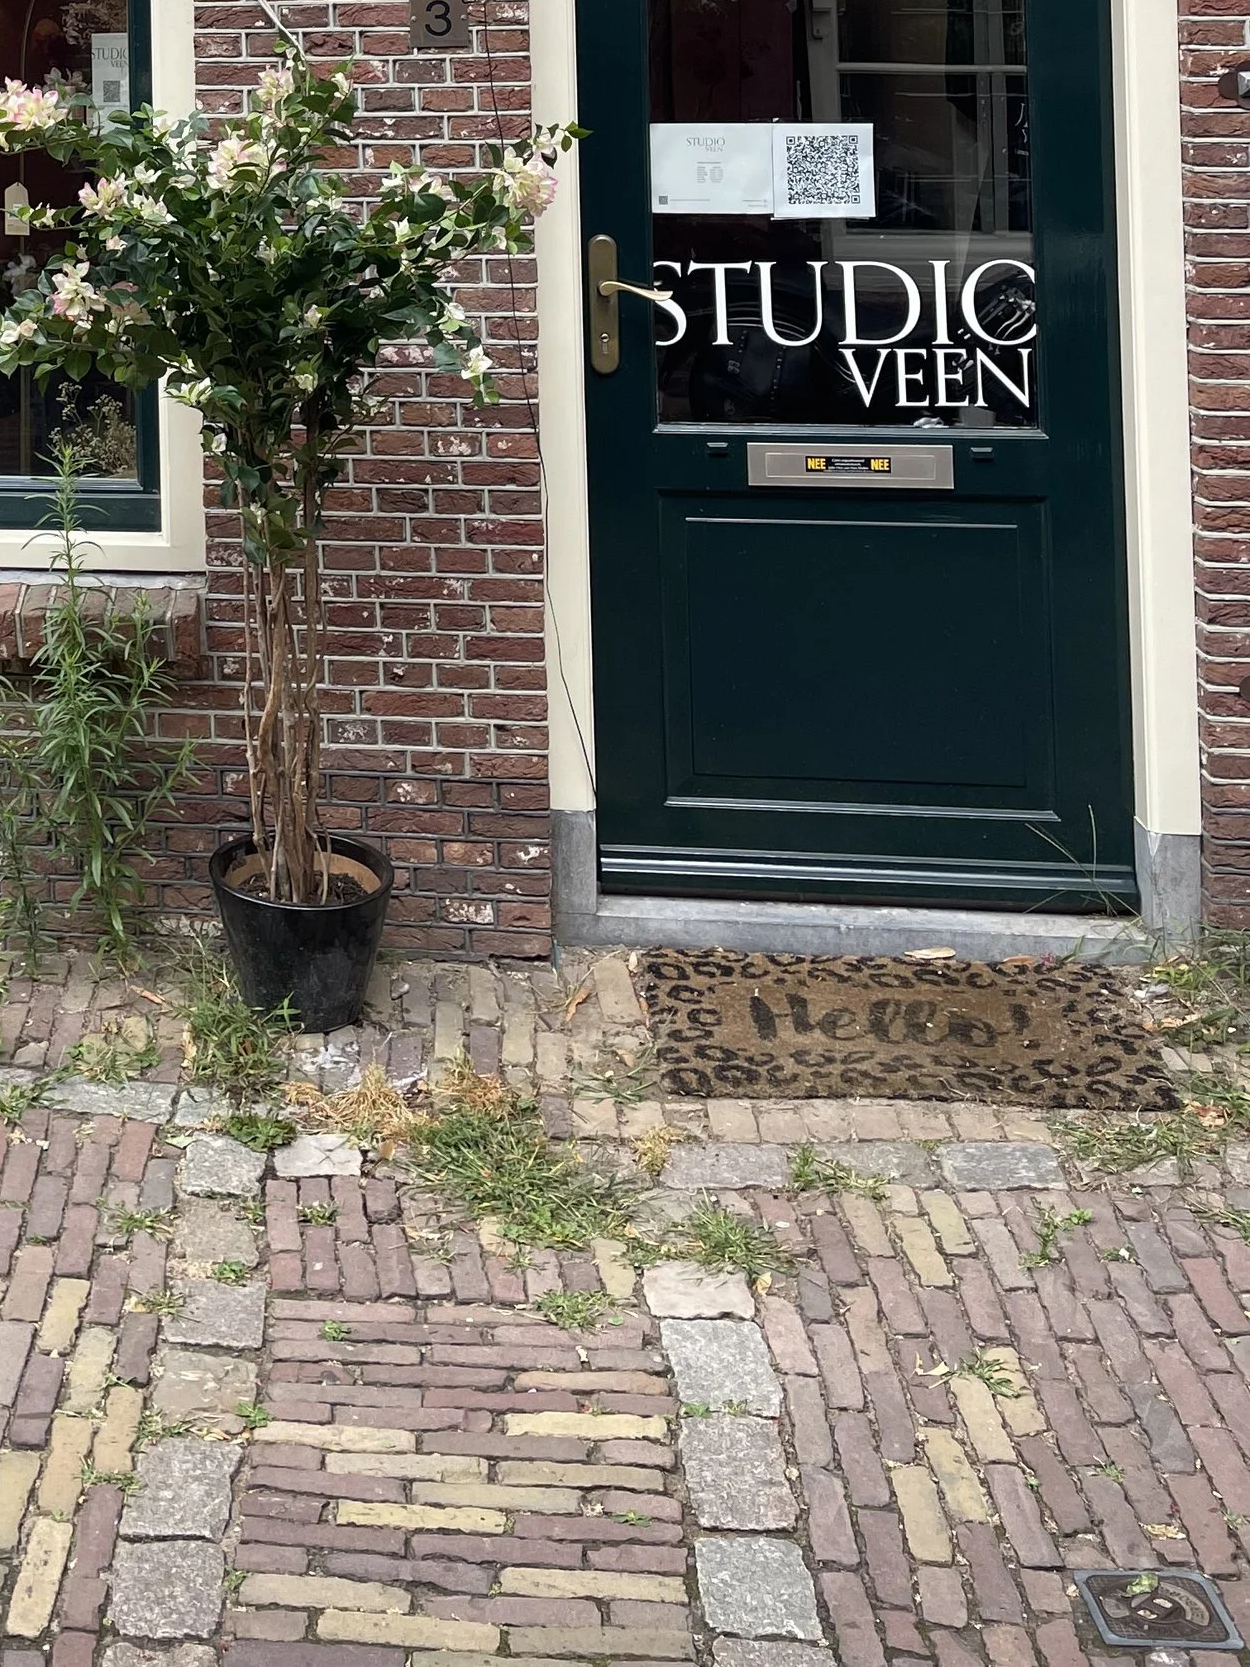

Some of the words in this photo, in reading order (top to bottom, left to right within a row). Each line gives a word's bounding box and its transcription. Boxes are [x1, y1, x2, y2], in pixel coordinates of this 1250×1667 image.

[425, 0, 452, 36] 3
[686, 137, 726, 148] STUDIO
[838, 348, 1033, 408] VEEN
[807, 458, 826, 470] NEE
[870, 459, 889, 471] NEE
[750, 991, 1041, 1050] Hello!
